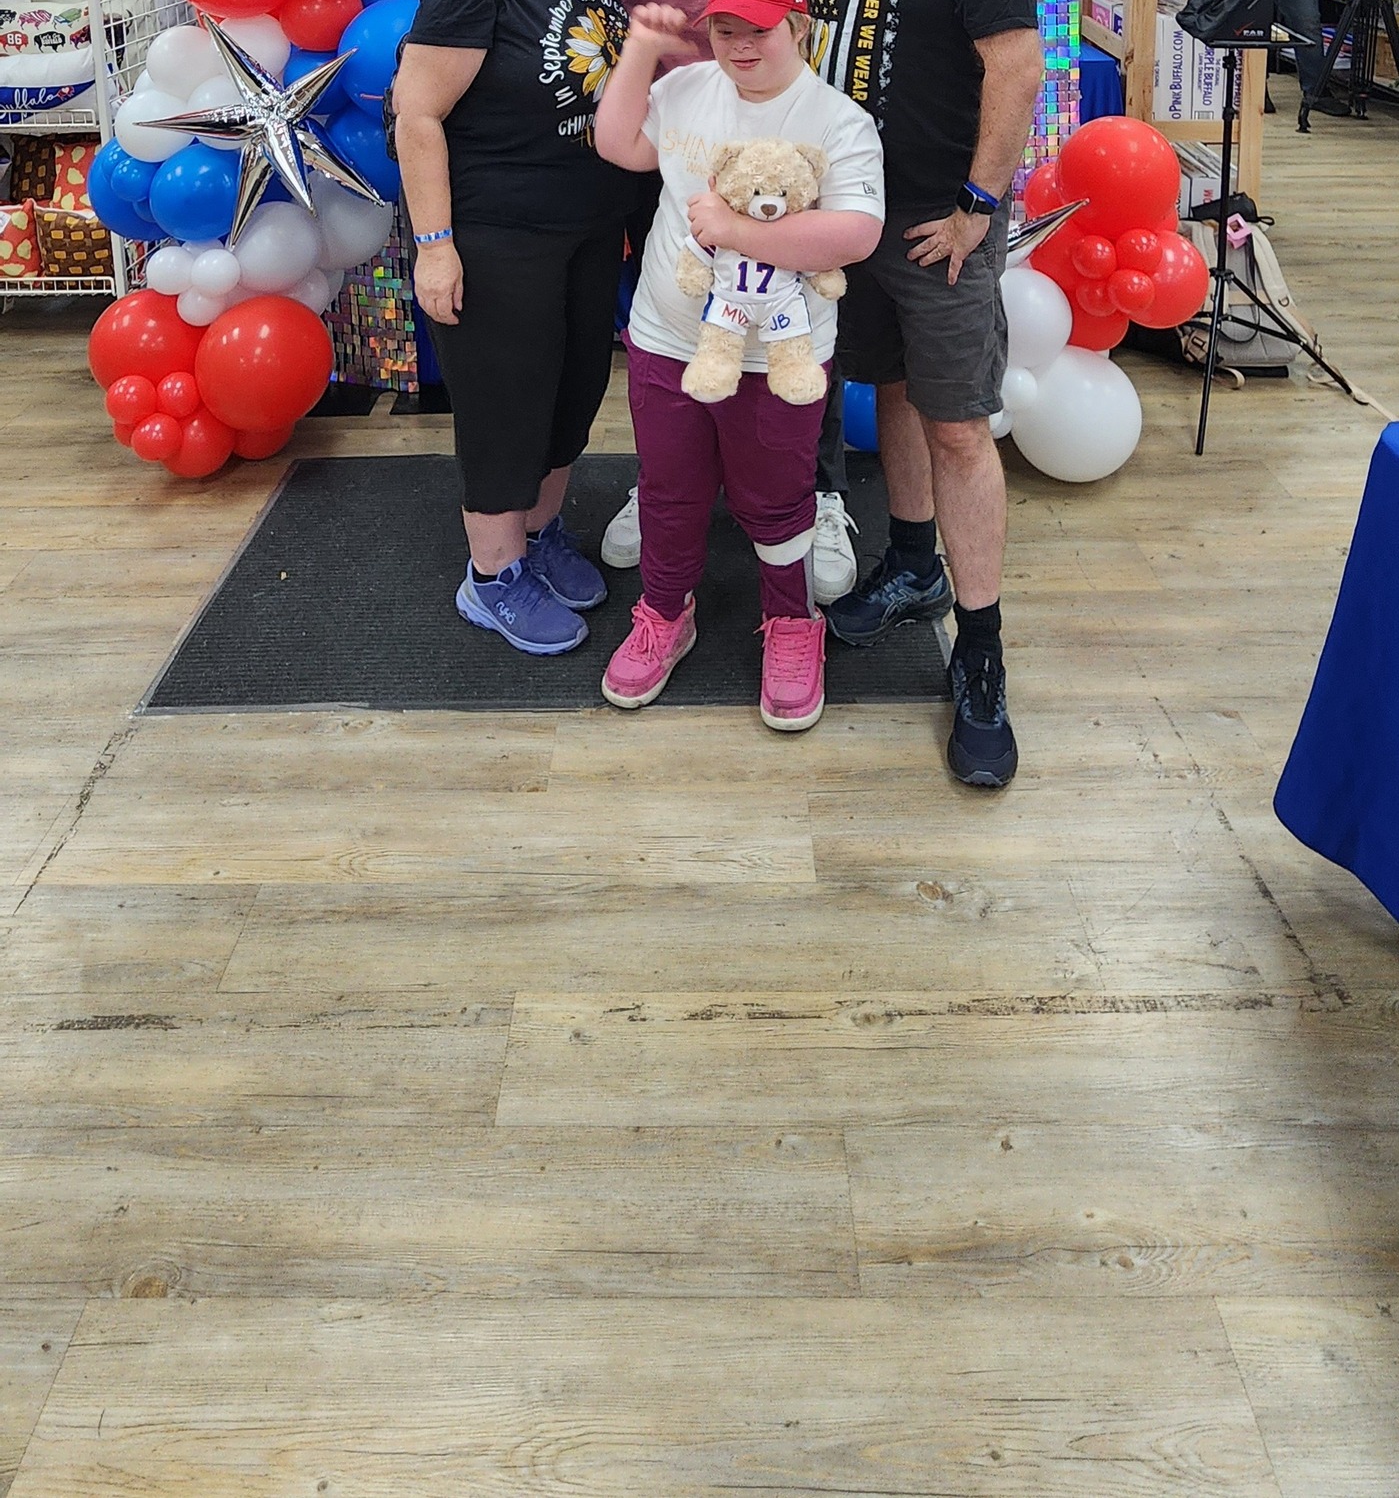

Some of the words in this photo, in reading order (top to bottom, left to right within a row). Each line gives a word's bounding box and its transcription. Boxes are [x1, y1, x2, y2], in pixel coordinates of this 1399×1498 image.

[7, 33, 22, 45] 86
[857, 24, 876, 50] WE
[1203, 45, 1215, 71] URPLE
[852, 54, 872, 101] WEAR
[1168, 30, 1184, 120] OPINKBUFFALO.COM
[1202, 73, 1214, 106] BUFFALO
[662, 128, 717, 162] SHIN
[736, 260, 776, 294] 17
[769, 313, 791, 331] JB
